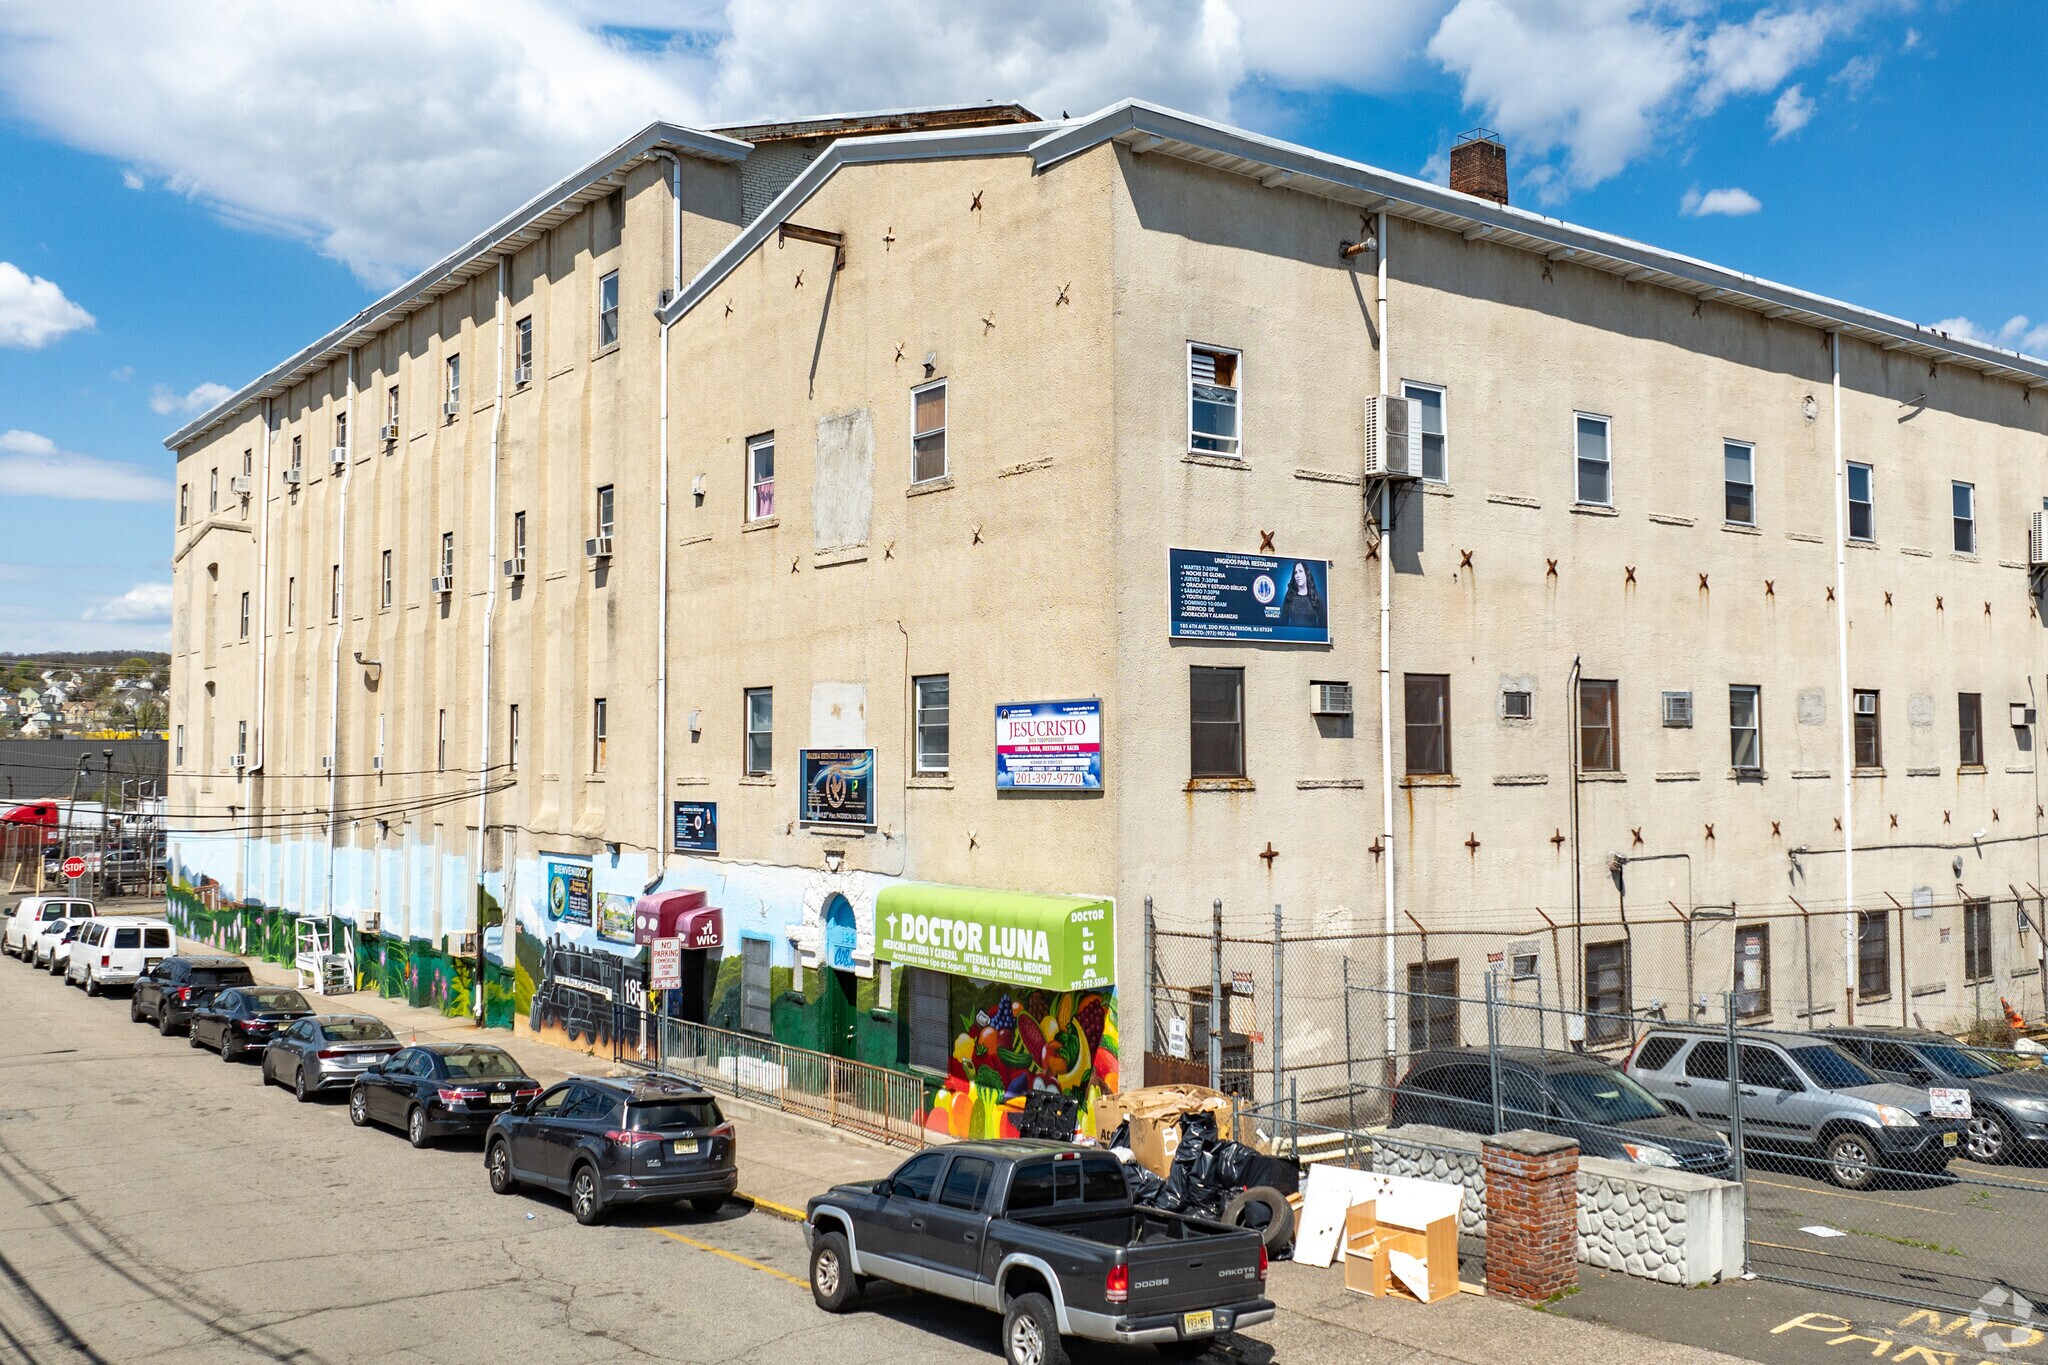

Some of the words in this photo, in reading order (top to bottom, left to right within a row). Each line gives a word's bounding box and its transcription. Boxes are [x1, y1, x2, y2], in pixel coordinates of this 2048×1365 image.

[1009, 719, 1086, 741] JESUCRISTO
[1015, 772, 1082, 785] 201-397-9770
[65, 862, 85, 873] STOP
[553, 864, 588, 878] BIENVENIDOS
[1071, 909, 1105, 923] DOCTOR
[696, 934, 718, 946] WIC
[901, 912, 983, 953] DOCTOR
[989, 925, 1051, 963] LUNA
[661, 941, 672, 950] NO
[882, 938, 907, 952] MEDICINA
[907, 943, 929, 956] INTERNA
[934, 948, 958, 962] GENERAL
[654, 949, 679, 958] PARKING
[892, 951, 918, 964] Aceptamos
[918, 955, 929, 964] todo
[929, 957, 940, 968] tipo
[947, 960, 967, 973] Seguros
[963, 952, 990, 967] INTERNAL
[996, 957, 1023, 973] GENERAL
[1023, 961, 1052, 976] MEDICINE
[972, 964, 981, 974] We
[980, 966, 999, 979] accept
[999, 968, 1013, 979] most
[1218, 1266, 1256, 1278] DAKOTA
[1134, 1278, 1170, 1289] DODGE
[1898, 1309, 2045, 1348] NO
